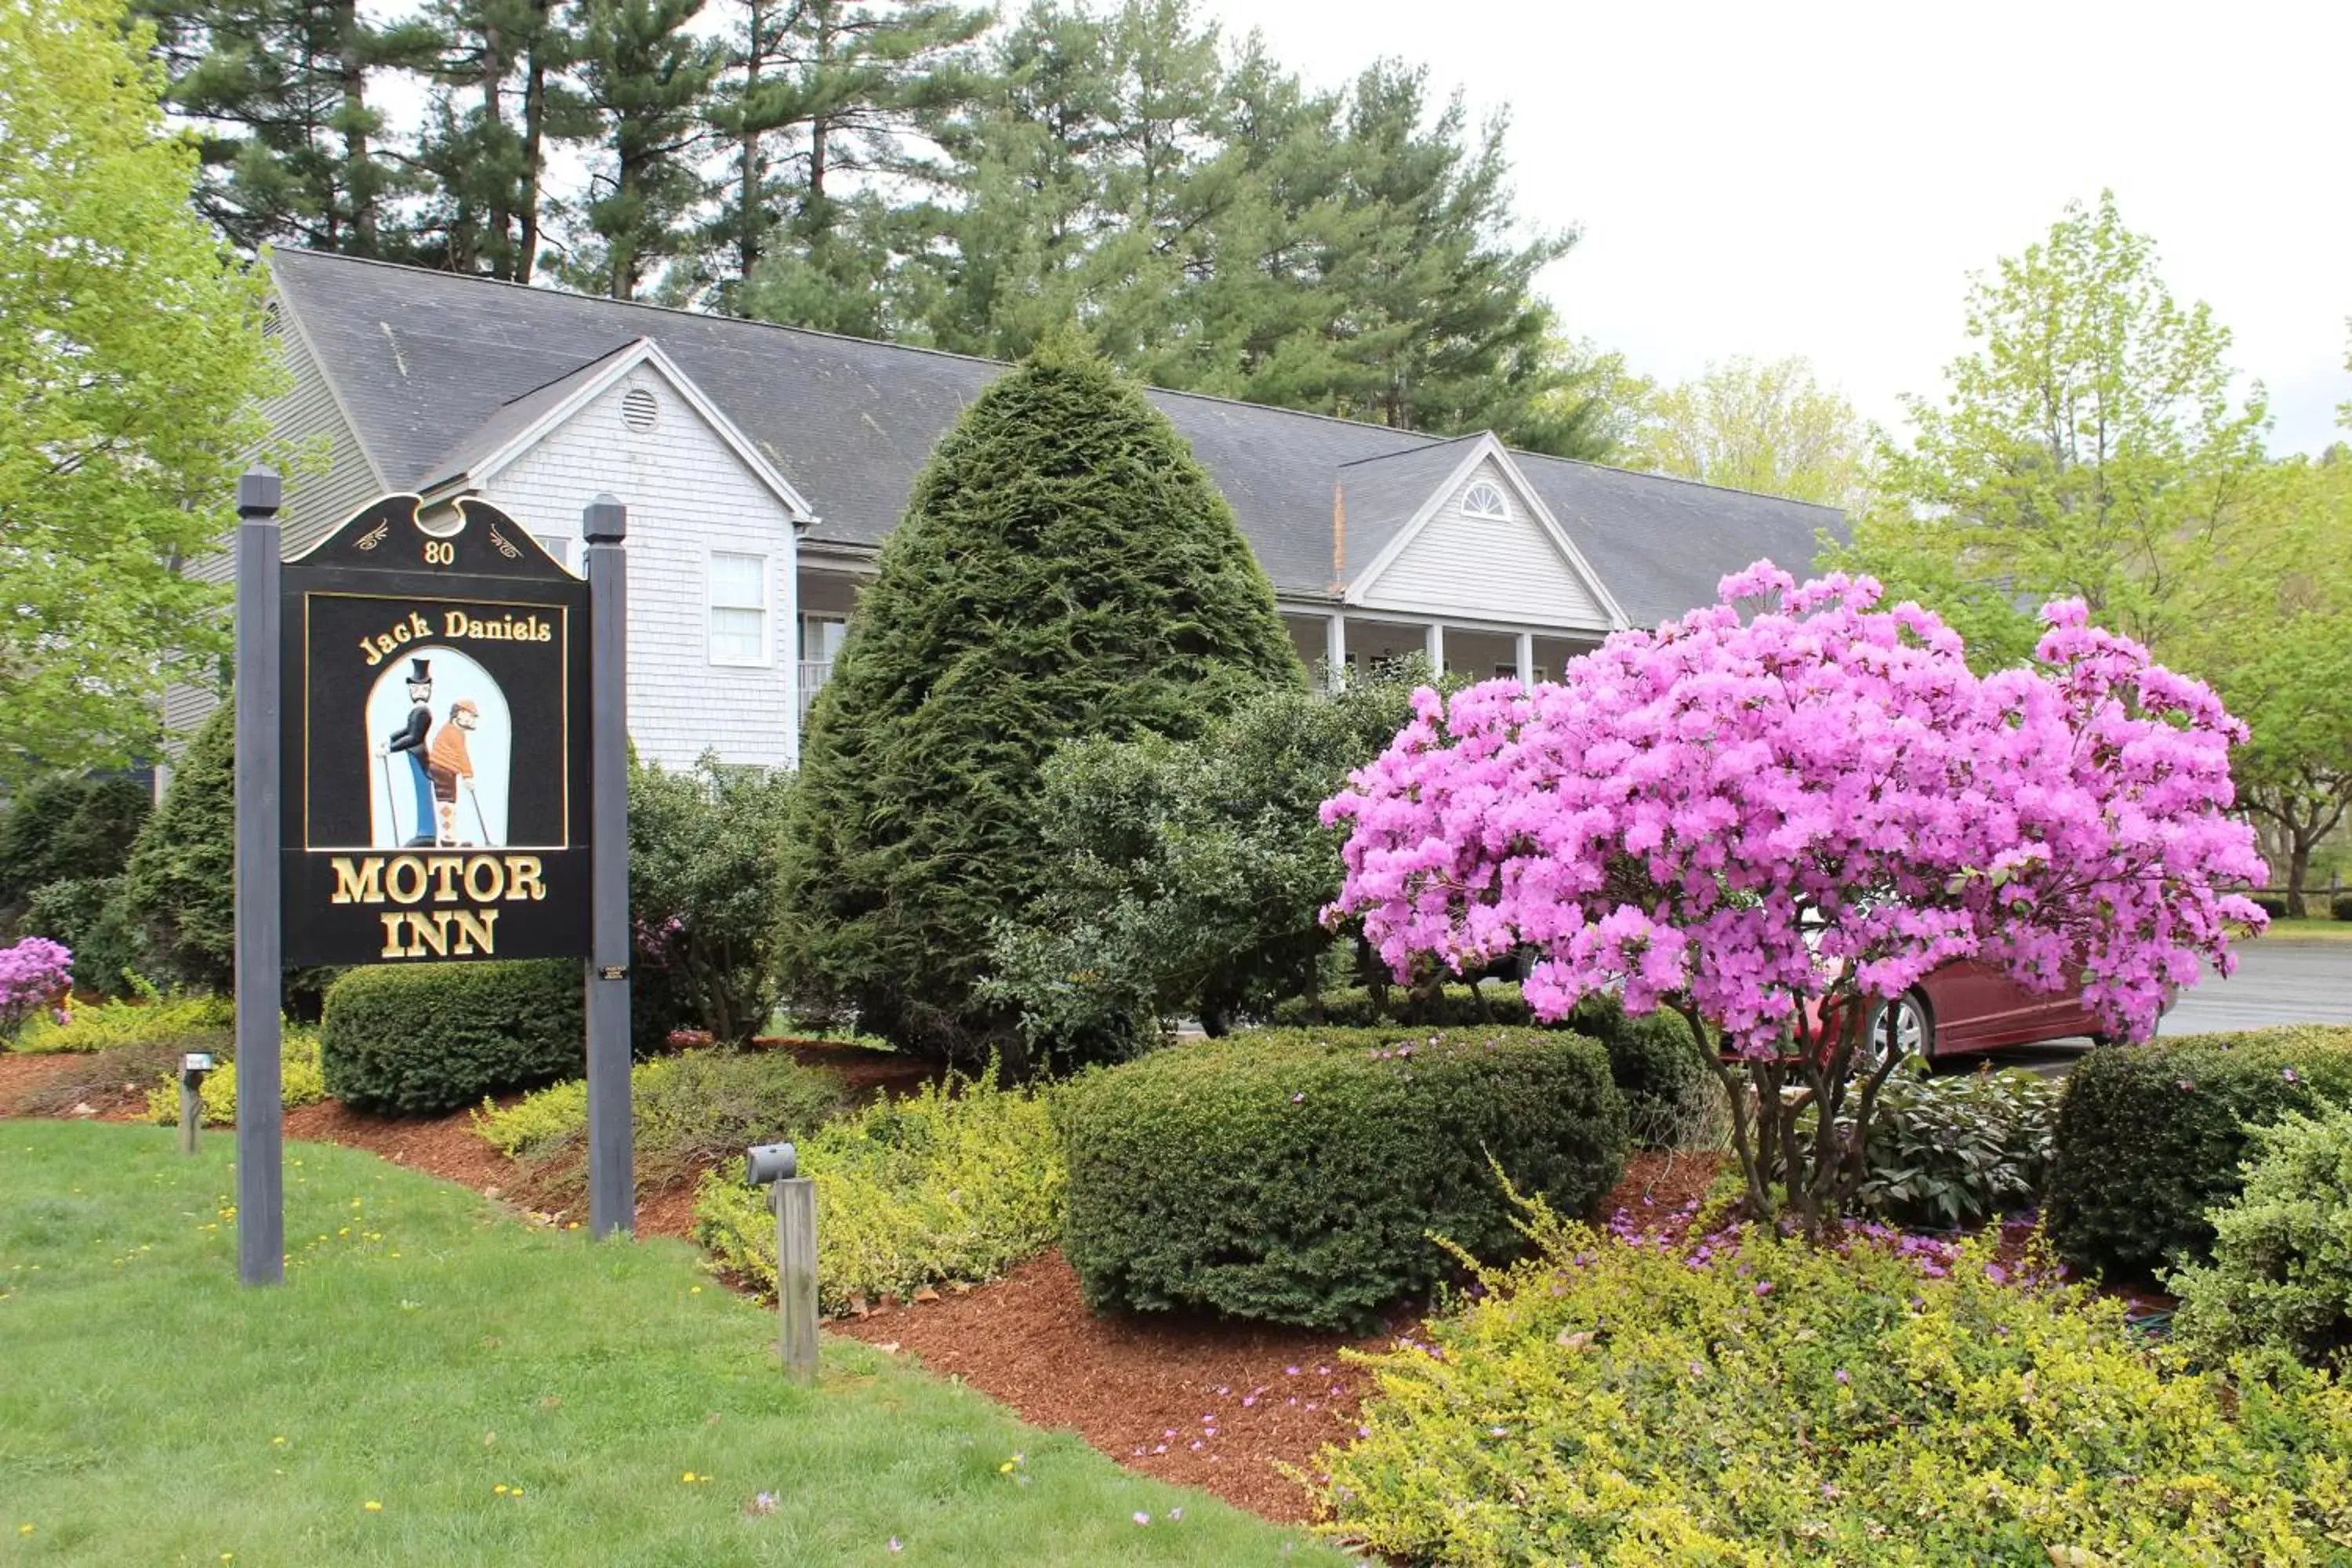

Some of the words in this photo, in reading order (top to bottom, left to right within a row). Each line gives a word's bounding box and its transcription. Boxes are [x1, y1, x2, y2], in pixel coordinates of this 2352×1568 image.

[424, 541, 455, 565] 80
[358, 610, 434, 666] Jack
[445, 611, 551, 642] Daniels
[331, 854, 546, 903] MOTOR
[380, 909, 499, 958] INN
